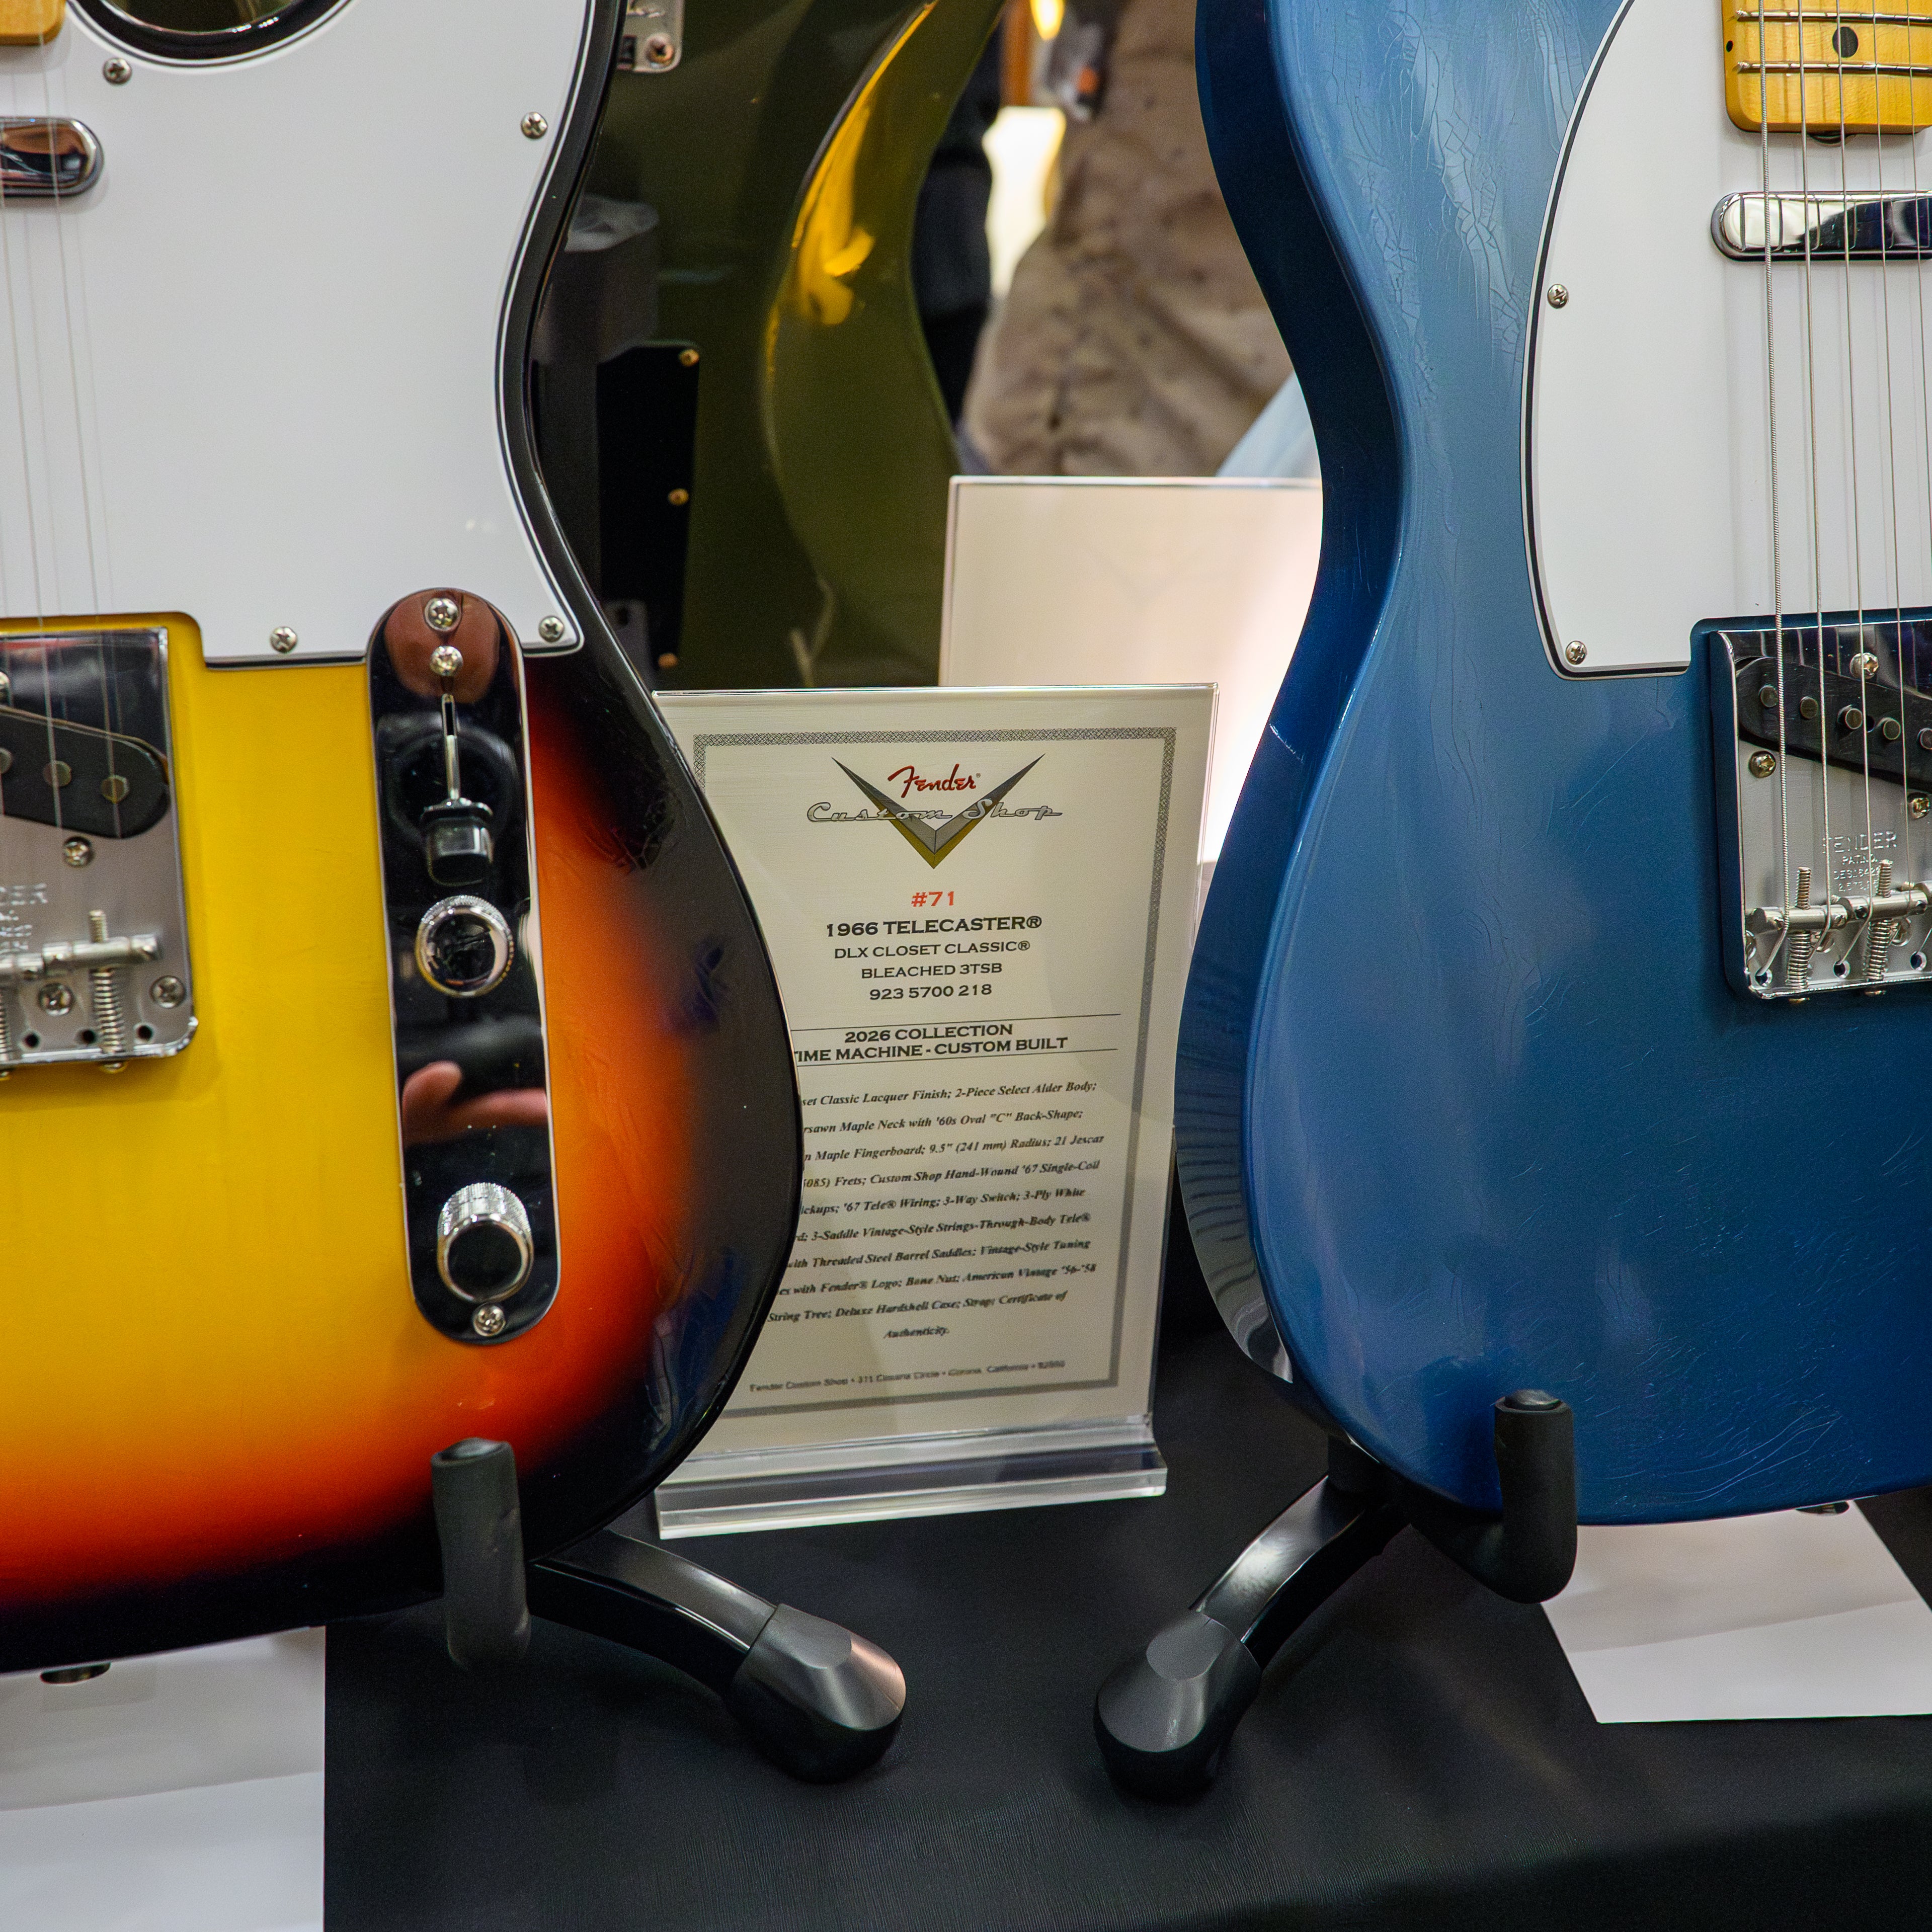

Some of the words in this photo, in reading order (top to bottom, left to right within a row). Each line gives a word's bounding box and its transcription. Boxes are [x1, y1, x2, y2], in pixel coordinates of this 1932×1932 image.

[806, 801, 953, 823] Custom
[961, 798, 1063, 822] Shop
[911, 890, 955, 908] #71
[826, 922, 878, 937] 1966
[883, 915, 1043, 935] TELECASTER®
[834, 946, 869, 959] DLX
[872, 943, 942, 957] CLOSET
[943, 939, 1030, 955] CLASSIC®
[861, 965, 957, 979] BLEACHED
[959, 962, 1002, 975] 3TSB
[869, 987, 905, 1001] 923
[908, 986, 953, 999] 5700
[958, 984, 992, 997] 218
[845, 1029, 891, 1043] 2026
[895, 1024, 1013, 1041] COLLECTION
[835, 1044, 922, 1060] MACHINE
[935, 1038, 1011, 1056] CUSTOM
[1015, 1036, 1068, 1051] BUILT
[802, 1097, 818, 1106] set
[821, 1094, 859, 1105] Classic
[863, 1093, 909, 1105] Lacquer
[912, 1089, 951, 1100] Finish;
[955, 1088, 995, 1097] 2-Piece
[998, 1085, 1030, 1095] Select
[1032, 1083, 1063, 1093] Alder
[1066, 1081, 1097, 1092] Body;
[840, 1120, 874, 1133] Maple
[878, 1118, 905, 1130] Neck
[909, 1117, 931, 1128] with
[960, 1114, 986, 1124] Oval
[1015, 1110, 1083, 1121] Back-Shape;
[815, 1150, 850, 1162] Maple
[854, 1145, 925, 1160] Fingerboard;
[956, 1142, 979, 1154] (241
[983, 1141, 1006, 1151] mm)
[1010, 1138, 1052, 1149] Radius;
[1054, 1137, 1066, 1146] 21
[1070, 1135, 1104, 1145] Jescar
[834, 1176, 866, 1186] Frets;
[870, 1174, 912, 1184] Custom
[914, 1172, 942, 1182] Shop
[944, 1165, 1019, 1180] Hand-Wound
[1039, 1159, 1101, 1174] Single-Coil
[801, 1205, 840, 1216] ickups;
[900, 1198, 940, 1208] Wiring;
[943, 1195, 978, 1206] 3-Way
[981, 1192, 1020, 1203] Switch;
[1023, 1189, 1052, 1200] 3-Ply
[1056, 1188, 1086, 1197] White
[811, 1228, 858, 1241] 3-Saddle
[863, 1224, 934, 1238] Vintage-Style
[813, 1255, 863, 1267] Threaded
[865, 1253, 893, 1263] Steel
[895, 1250, 930, 1261] Barrel
[793, 1284, 816, 1293] with
[767, 1312, 801, 1323] String
